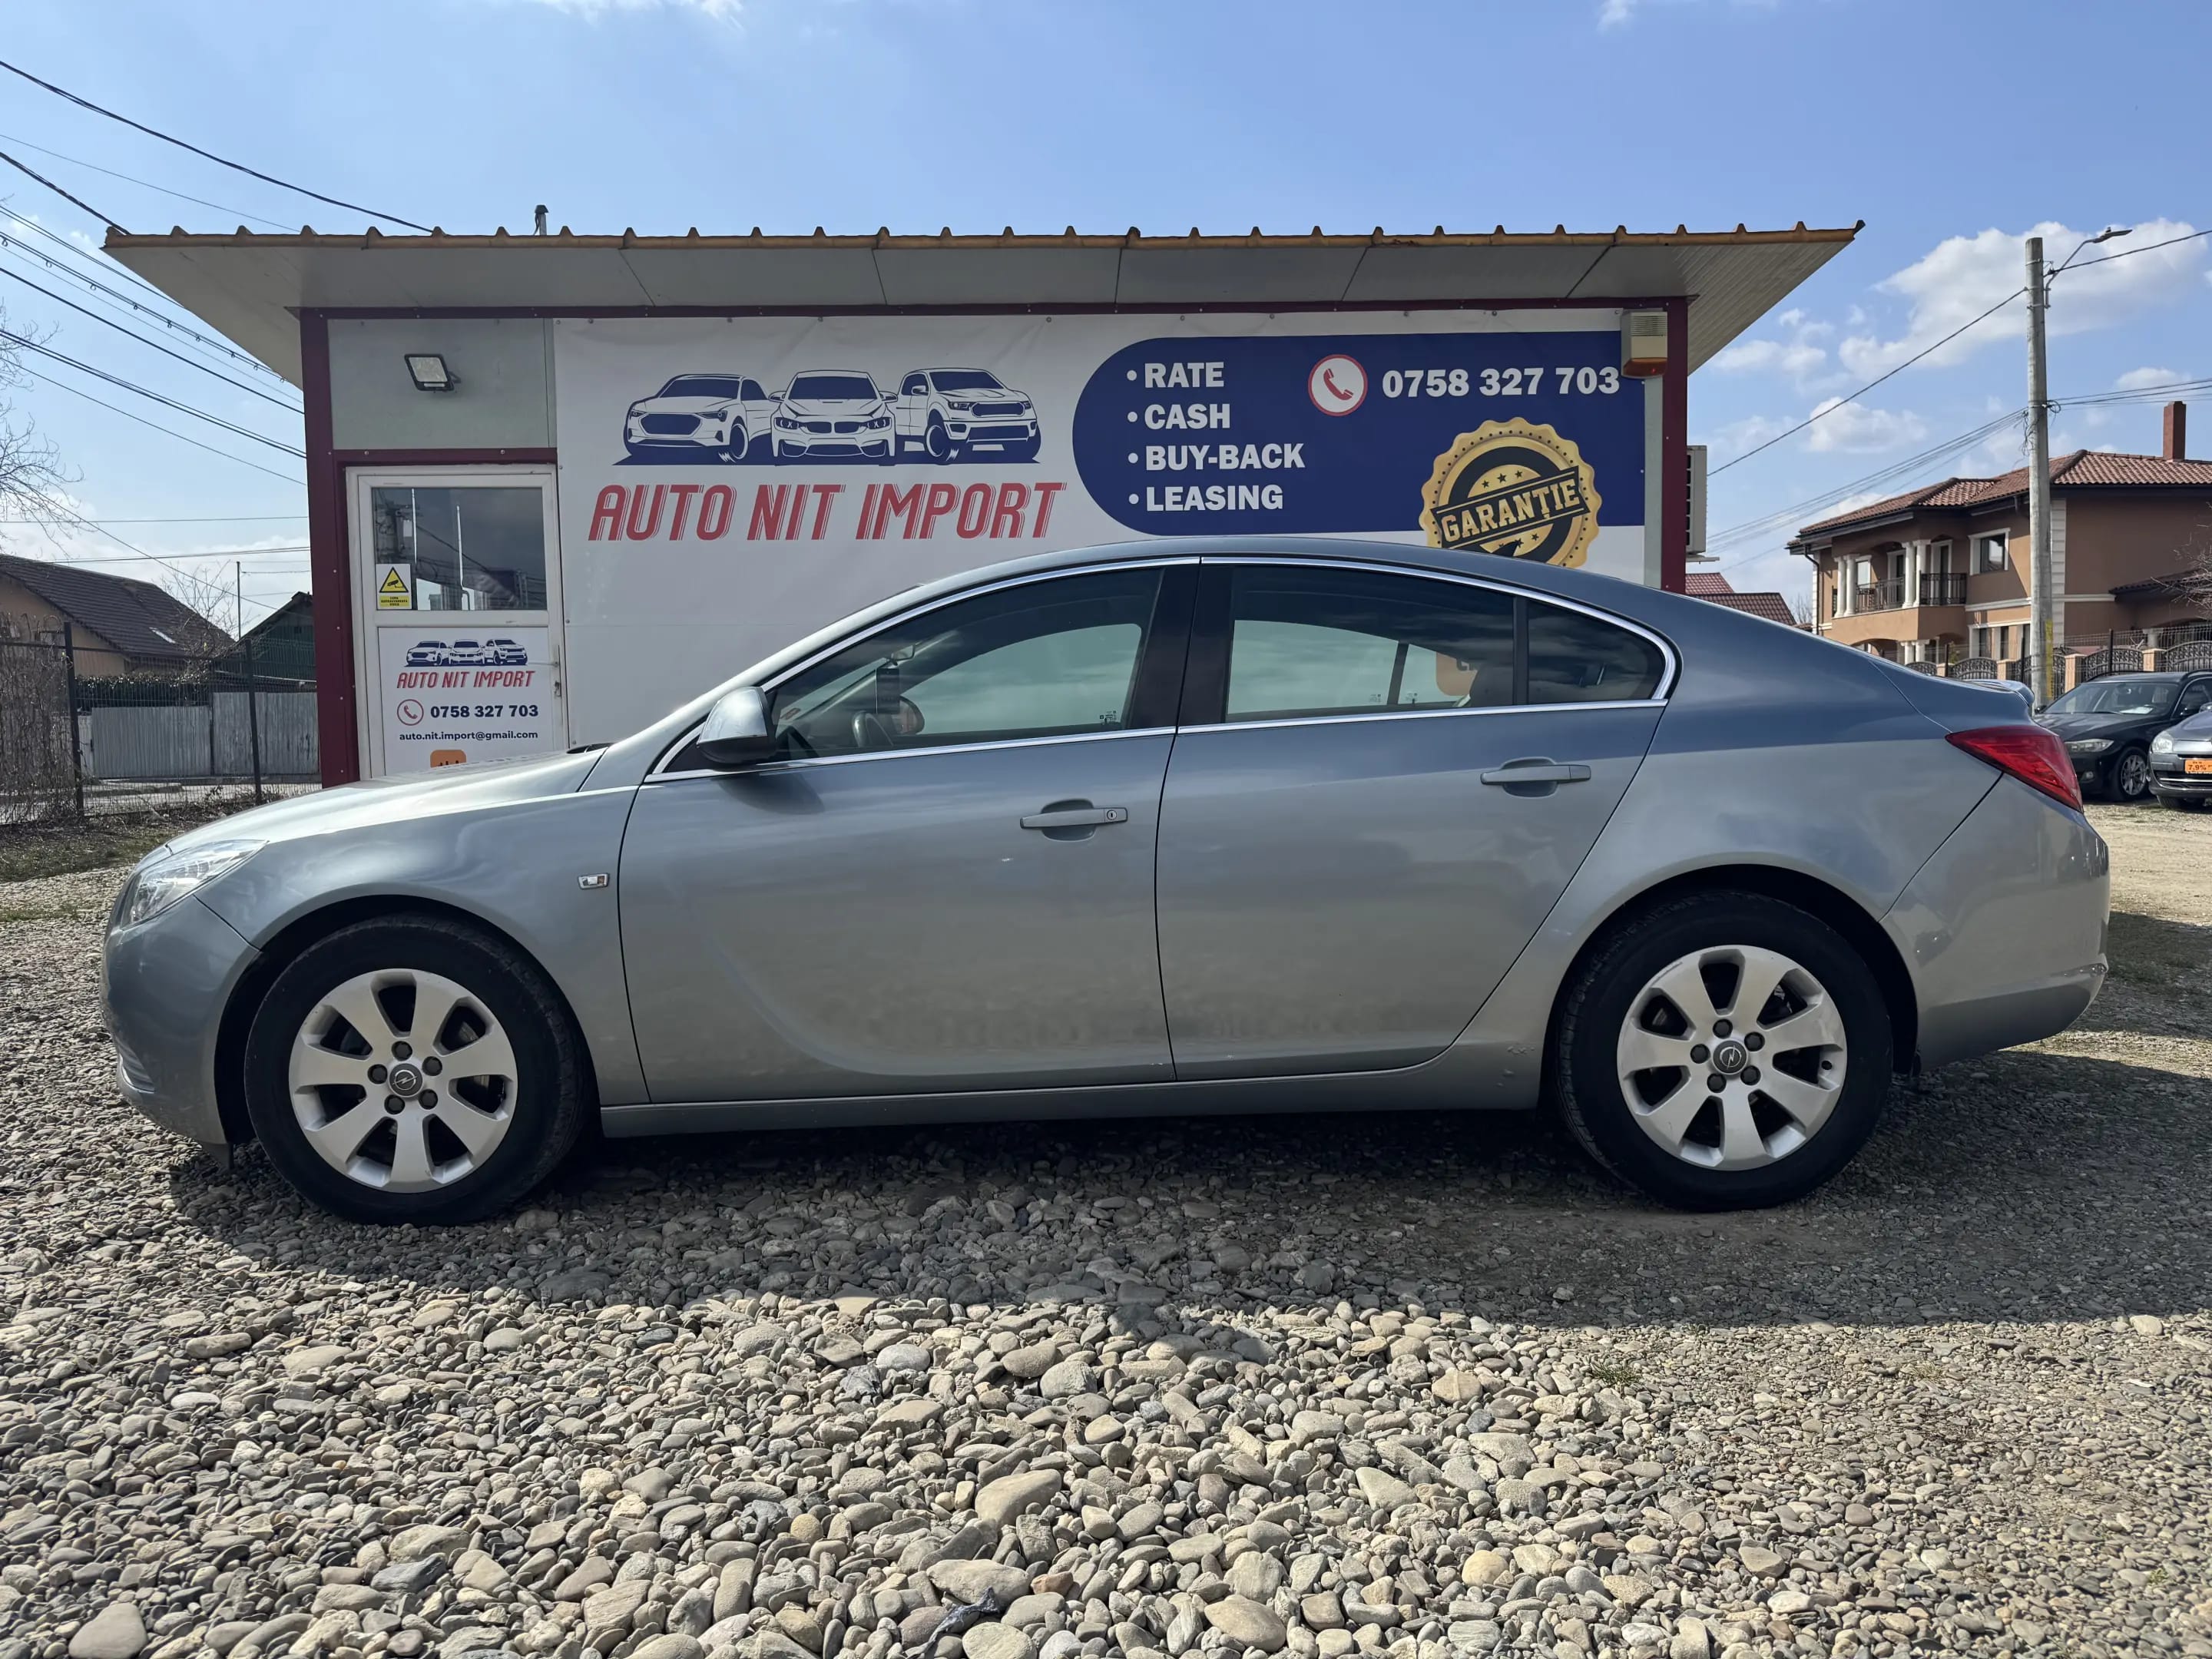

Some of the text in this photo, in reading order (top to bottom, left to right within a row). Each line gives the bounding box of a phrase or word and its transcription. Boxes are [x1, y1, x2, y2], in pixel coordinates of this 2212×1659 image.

[1144, 362, 1224, 388] RATE
[1382, 366, 1620, 398] 0758 327 703
[1144, 403, 1230, 429] CASH
[1146, 443, 1306, 470] BUY-BACK
[588, 482, 1067, 541] AUTO NIT IMPORT
[1146, 485, 1283, 512] LEASING
[396, 671, 535, 689] AUTO NIT IMPORT
[430, 704, 538, 718] 0758 327 703
[399, 730, 538, 741] auto.nit.import@gmail.com
